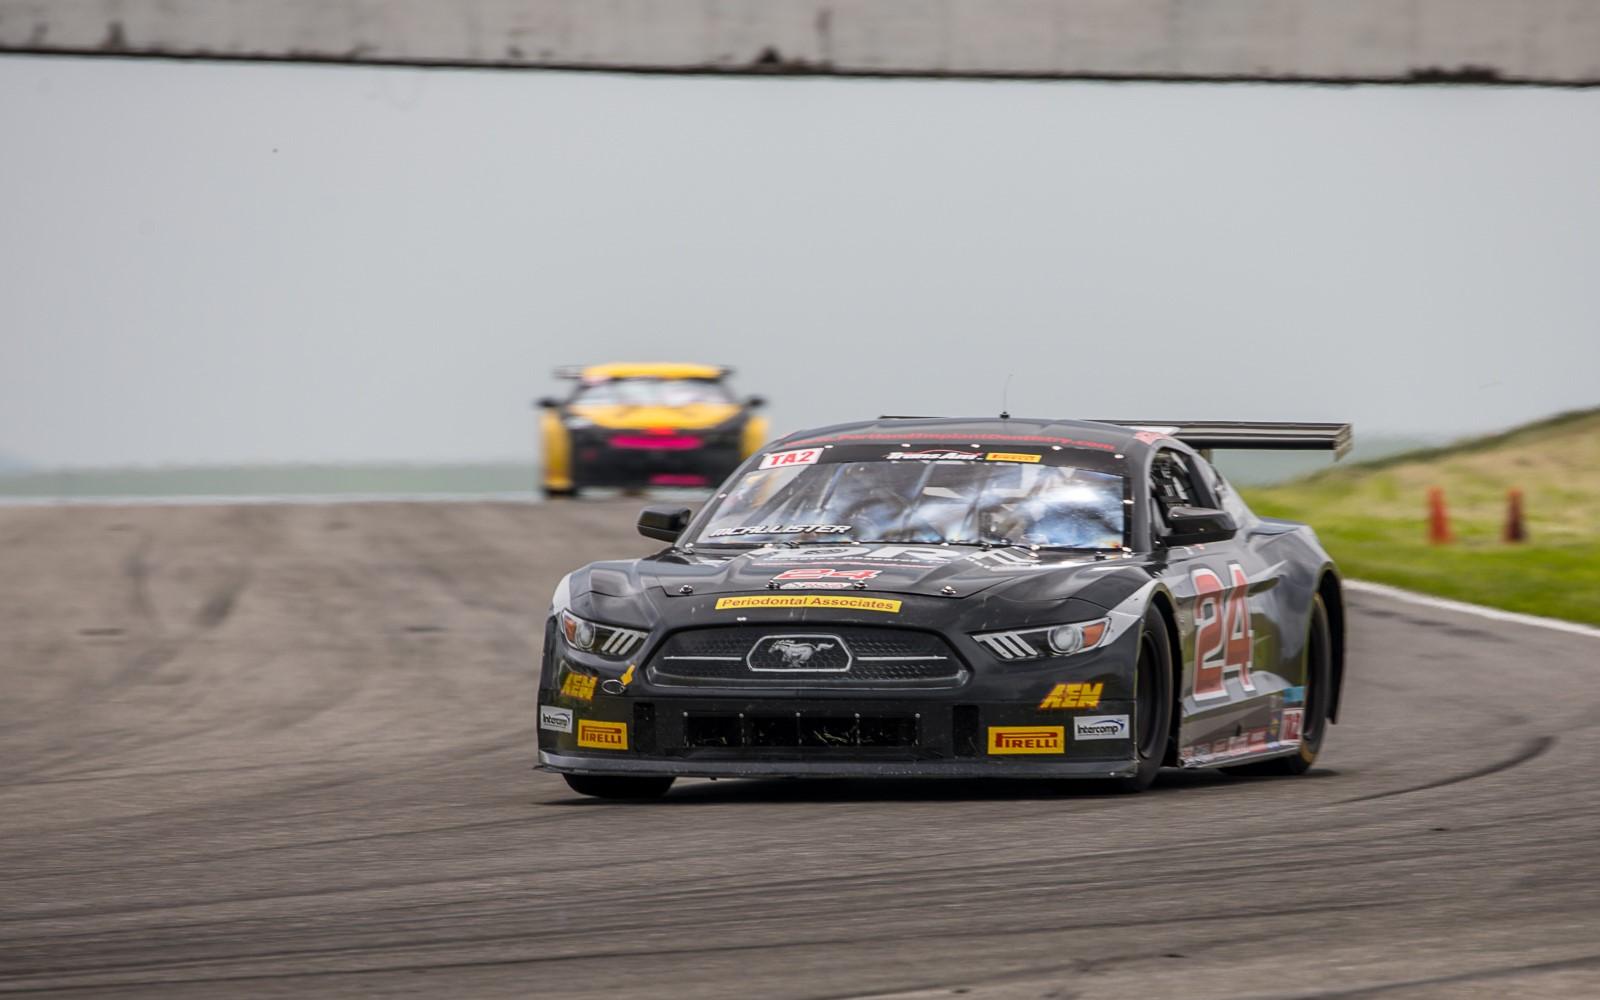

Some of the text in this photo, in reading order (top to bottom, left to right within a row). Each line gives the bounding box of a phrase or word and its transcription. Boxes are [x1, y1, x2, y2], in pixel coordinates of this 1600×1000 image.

[770, 450, 815, 466] TA2
[709, 524, 852, 538] MCALLISTER
[773, 568, 882, 581] 24
[722, 597, 894, 610] Periodontal Associates
[1191, 562, 1256, 702] 24
[561, 670, 598, 701] AEM
[1038, 682, 1104, 709] AEM
[581, 725, 622, 745] PIRELLI
[1077, 723, 1119, 735] Intercomp
[995, 731, 1058, 748] PIRELLI
